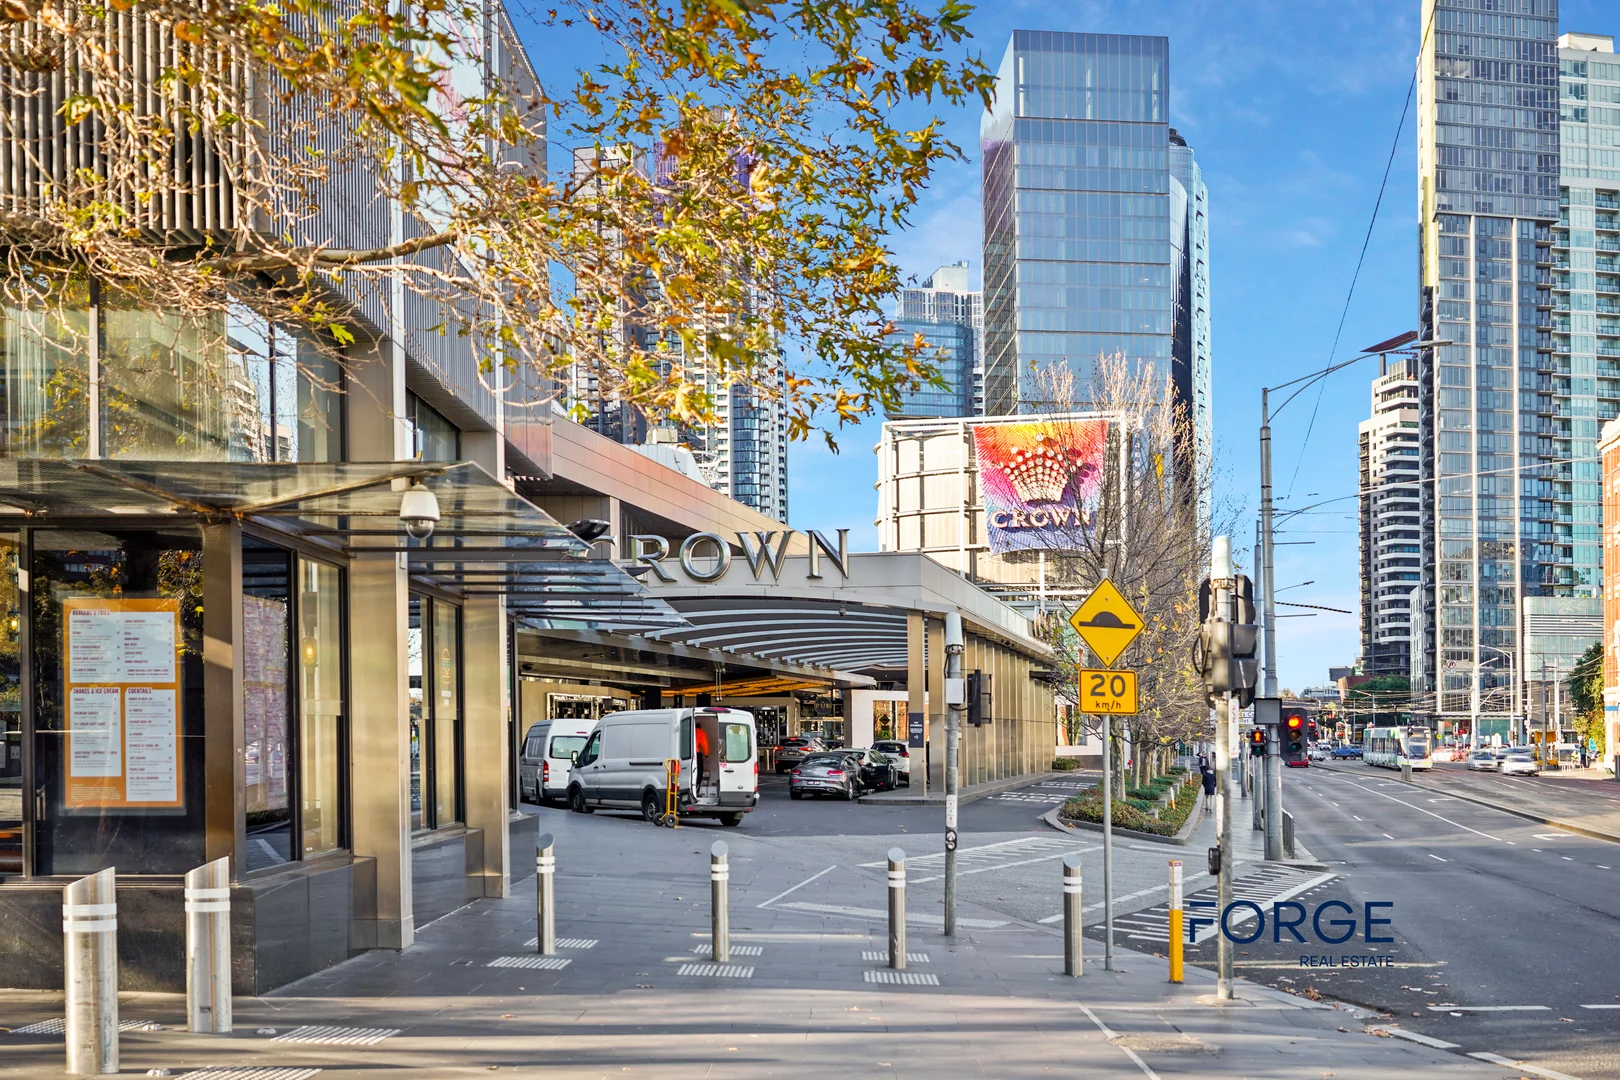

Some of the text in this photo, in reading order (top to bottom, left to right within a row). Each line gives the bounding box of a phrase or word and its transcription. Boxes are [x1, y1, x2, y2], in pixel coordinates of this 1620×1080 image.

[990, 507, 1091, 528] CROWN
[1090, 674, 1126, 698] 20
[1096, 700, 1121, 709] km/h
